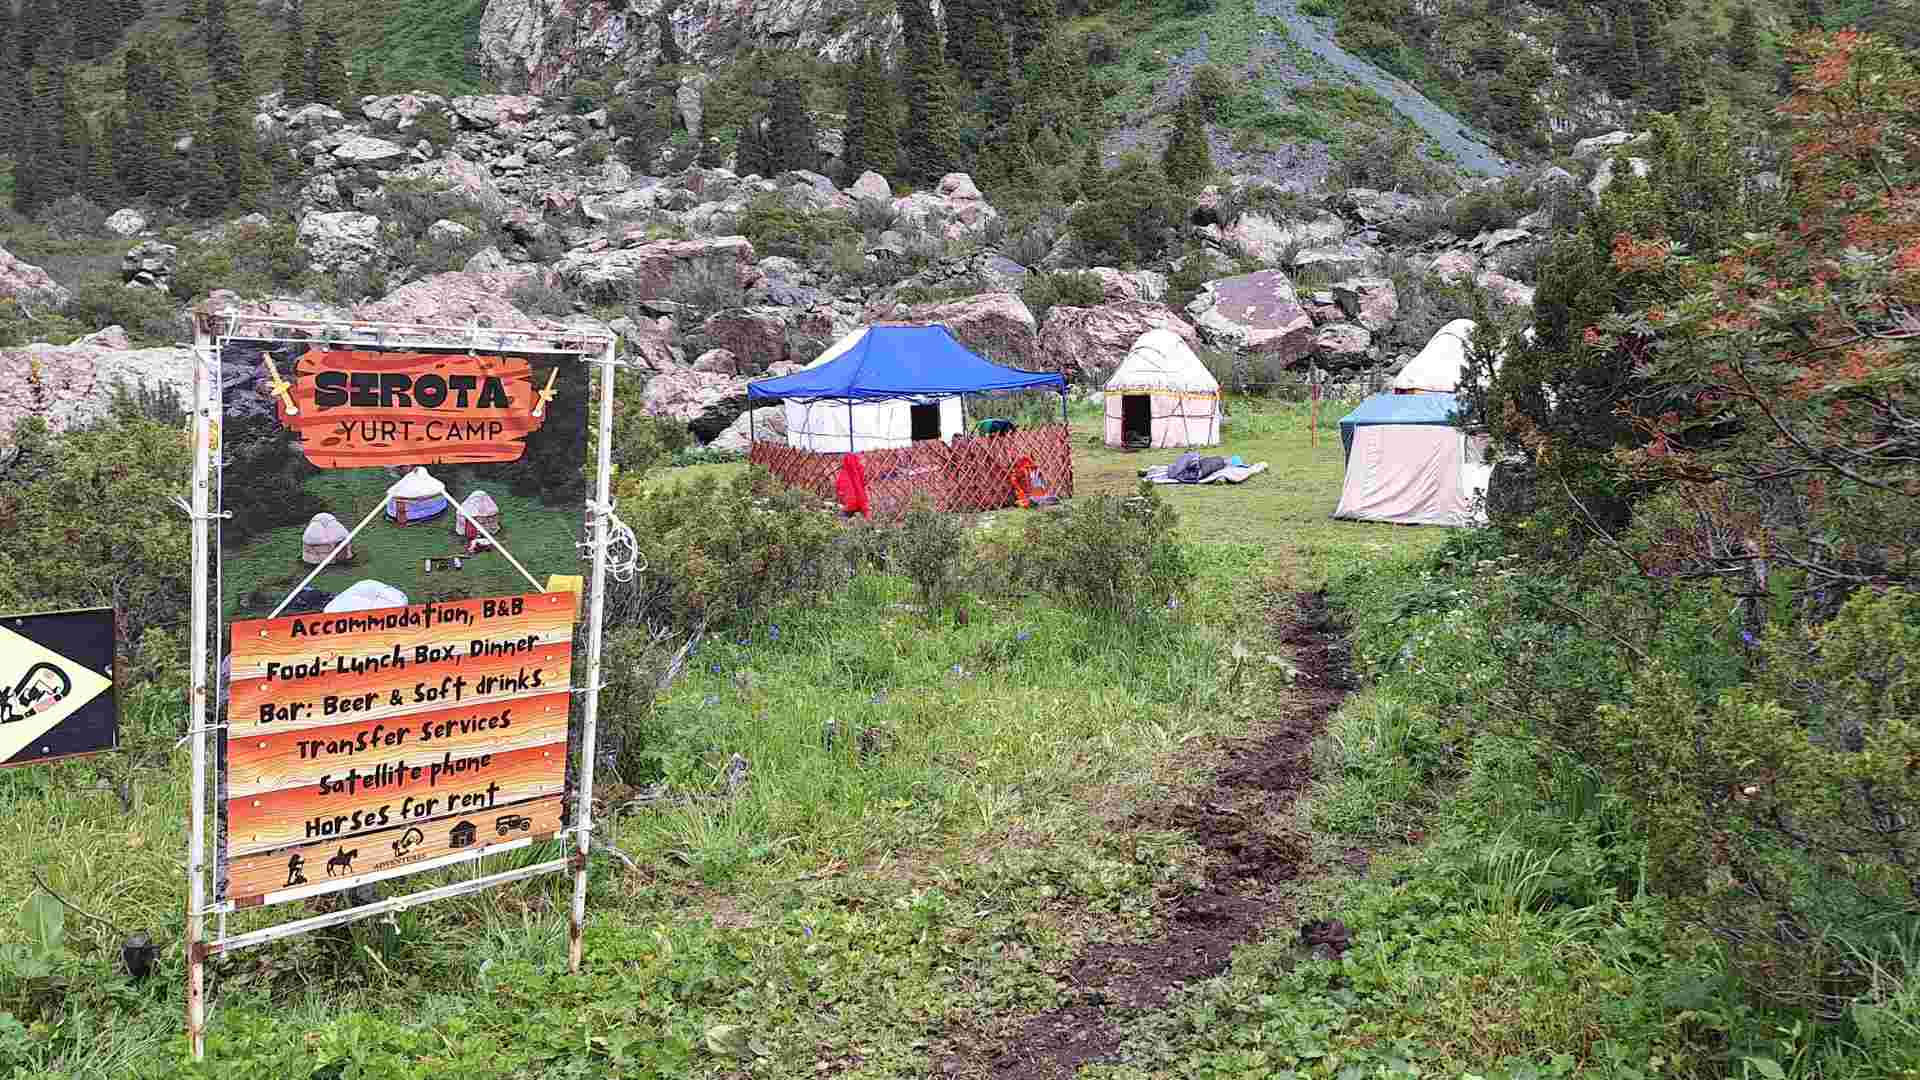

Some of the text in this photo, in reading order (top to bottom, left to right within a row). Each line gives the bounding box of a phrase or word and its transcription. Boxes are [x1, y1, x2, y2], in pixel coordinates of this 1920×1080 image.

[315, 371, 510, 409] SIROTA
[342, 420, 502, 442] YURT CAMP
[291, 598, 524, 638] Accommodation, B&B
[267, 634, 540, 681] Food: Lunch Box, Dinner
[259, 668, 541, 723] Bar: Beer & Soft drinks
[296, 709, 512, 759] Transfer Services
[318, 752, 491, 796] Satellite phone
[305, 783, 500, 837] Horses for rent
